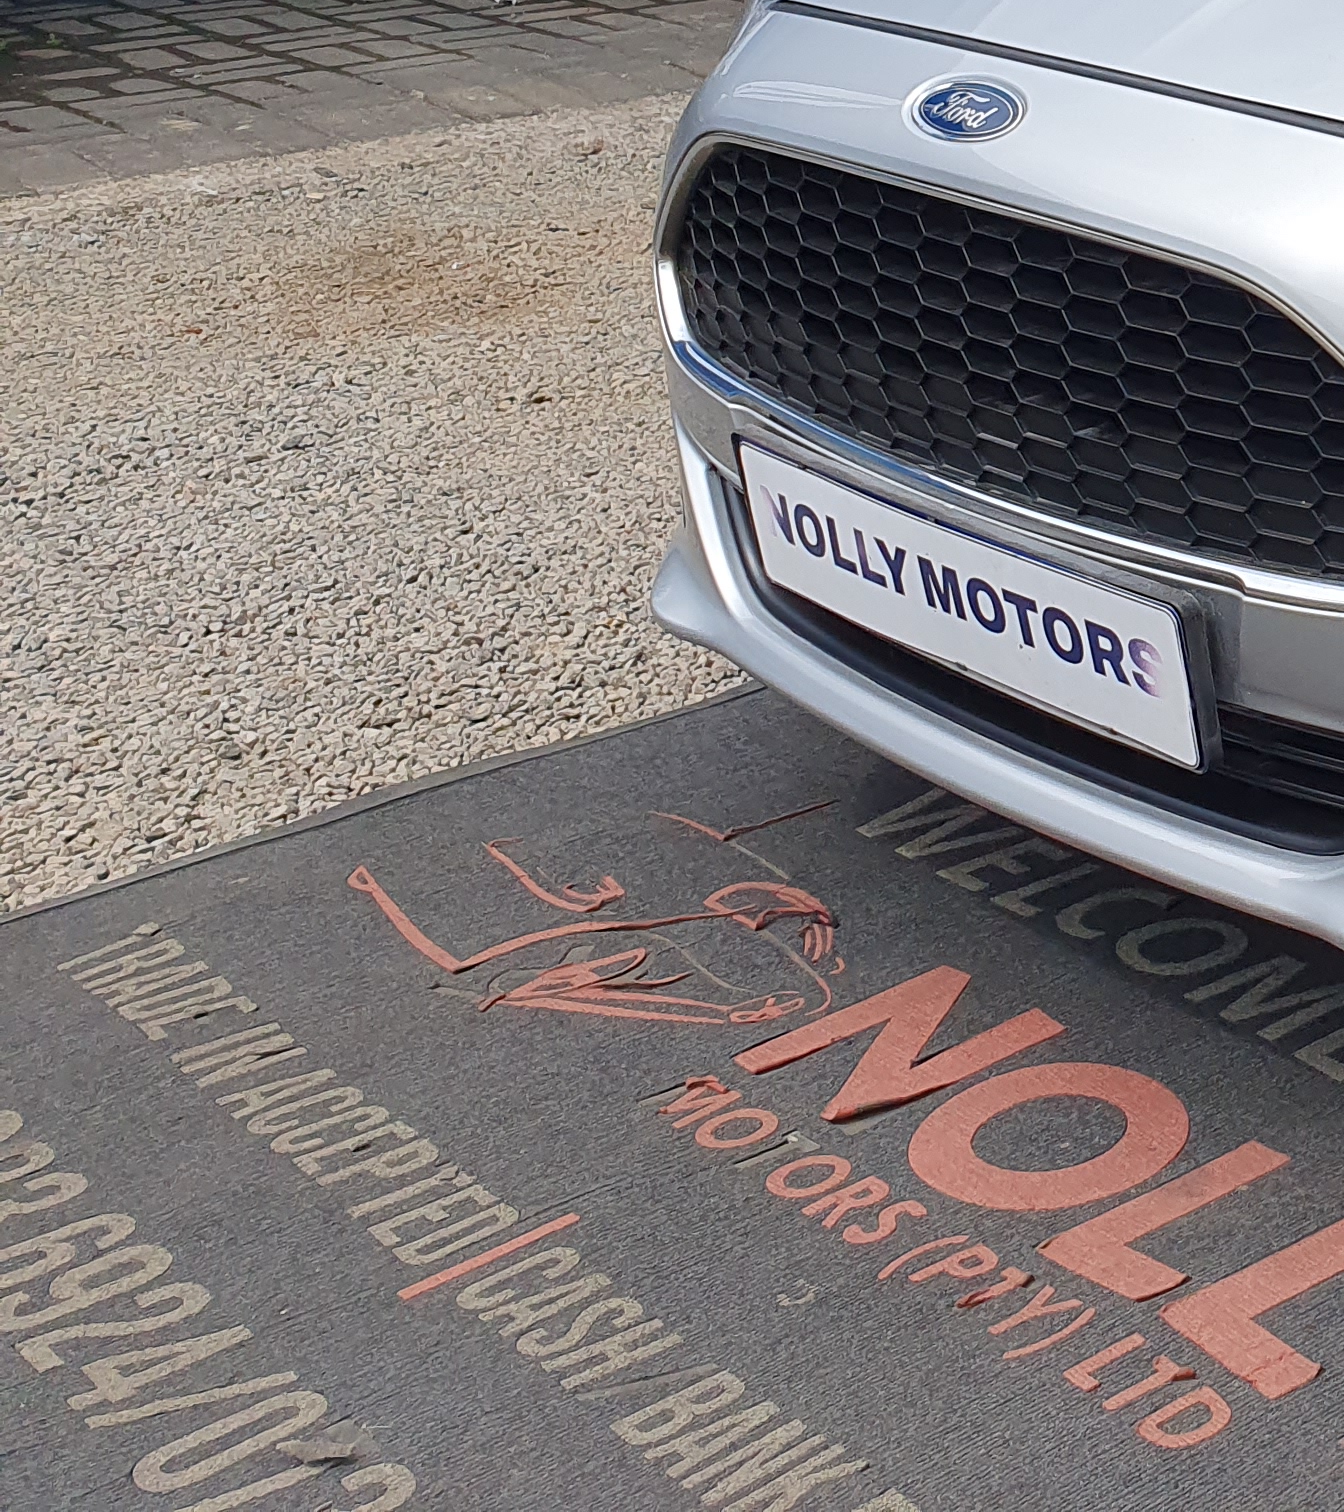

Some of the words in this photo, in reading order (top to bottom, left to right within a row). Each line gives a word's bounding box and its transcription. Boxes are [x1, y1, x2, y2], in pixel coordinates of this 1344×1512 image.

[934, 90, 999, 129] Ford
[760, 484, 907, 595] NOLLY
[917, 555, 1164, 698] MOTORS
[57, 921, 260, 1041] TRADE
[170, 1021, 309, 1087] IN
[214, 1067, 521, 1266] ACCEPTED
[876, 1234, 1096, 1361] (PTY)
[1063, 1331, 1232, 1449] LTD
